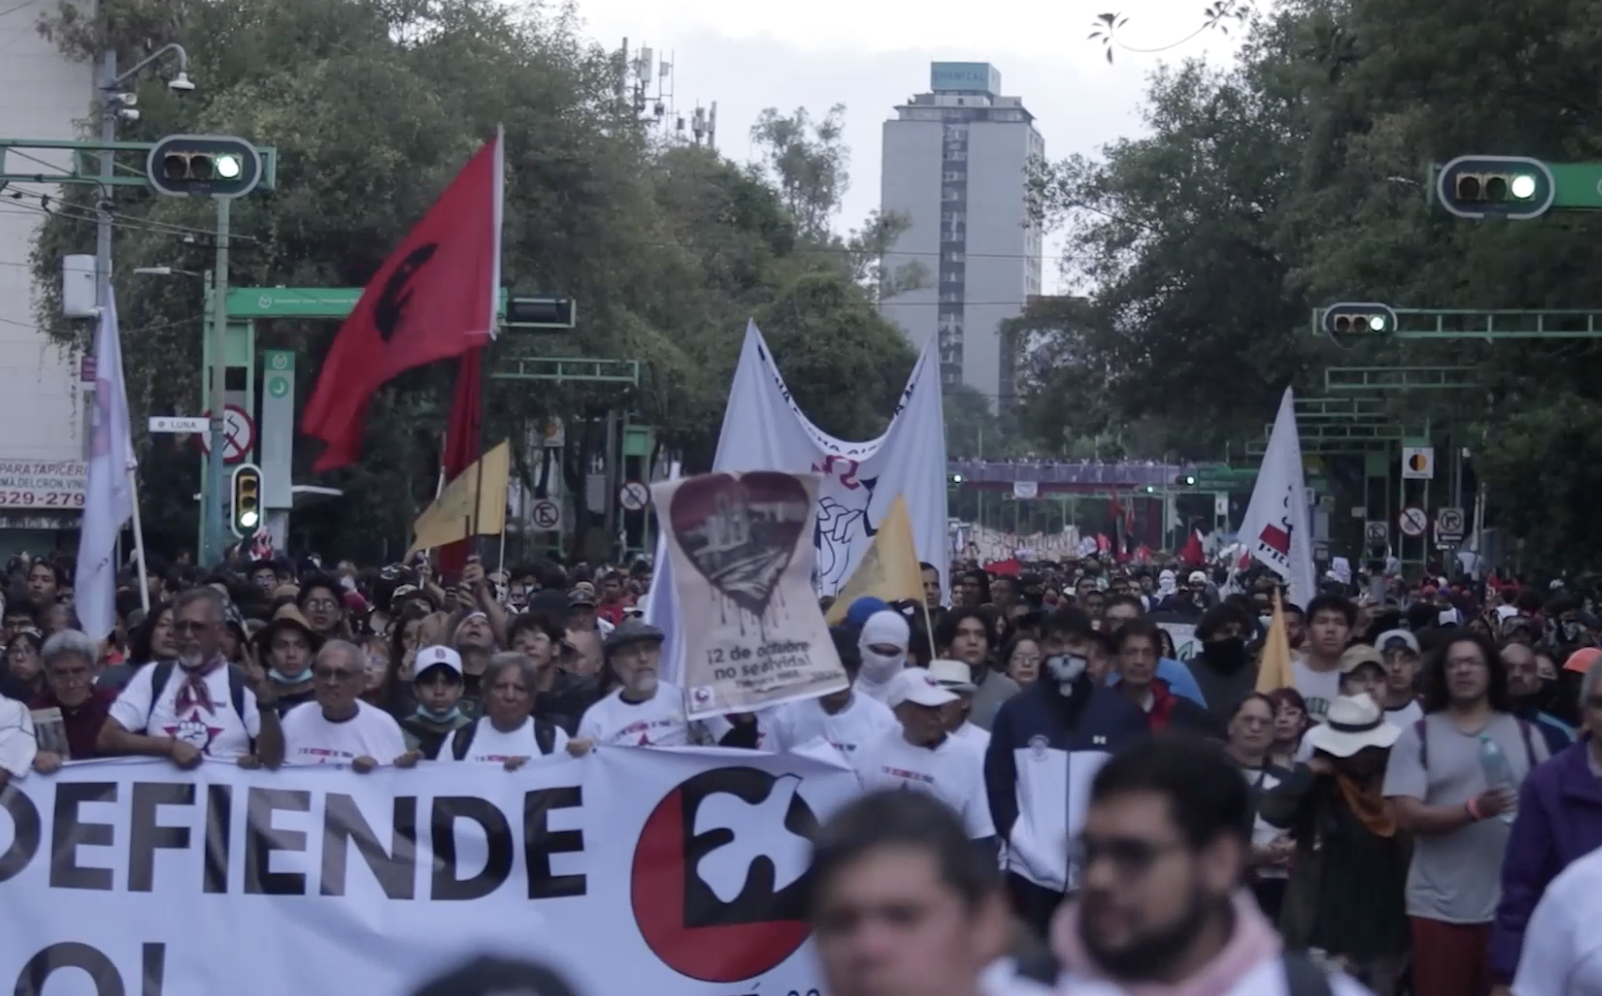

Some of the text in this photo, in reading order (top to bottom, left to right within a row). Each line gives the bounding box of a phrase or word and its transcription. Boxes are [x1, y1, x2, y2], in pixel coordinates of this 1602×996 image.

[170, 420, 197, 429] LUNA
[0, 463, 31, 475] PARA
[729, 645, 752, 661] de
[757, 640, 810, 657] octubre
[714, 666, 737, 680] no
